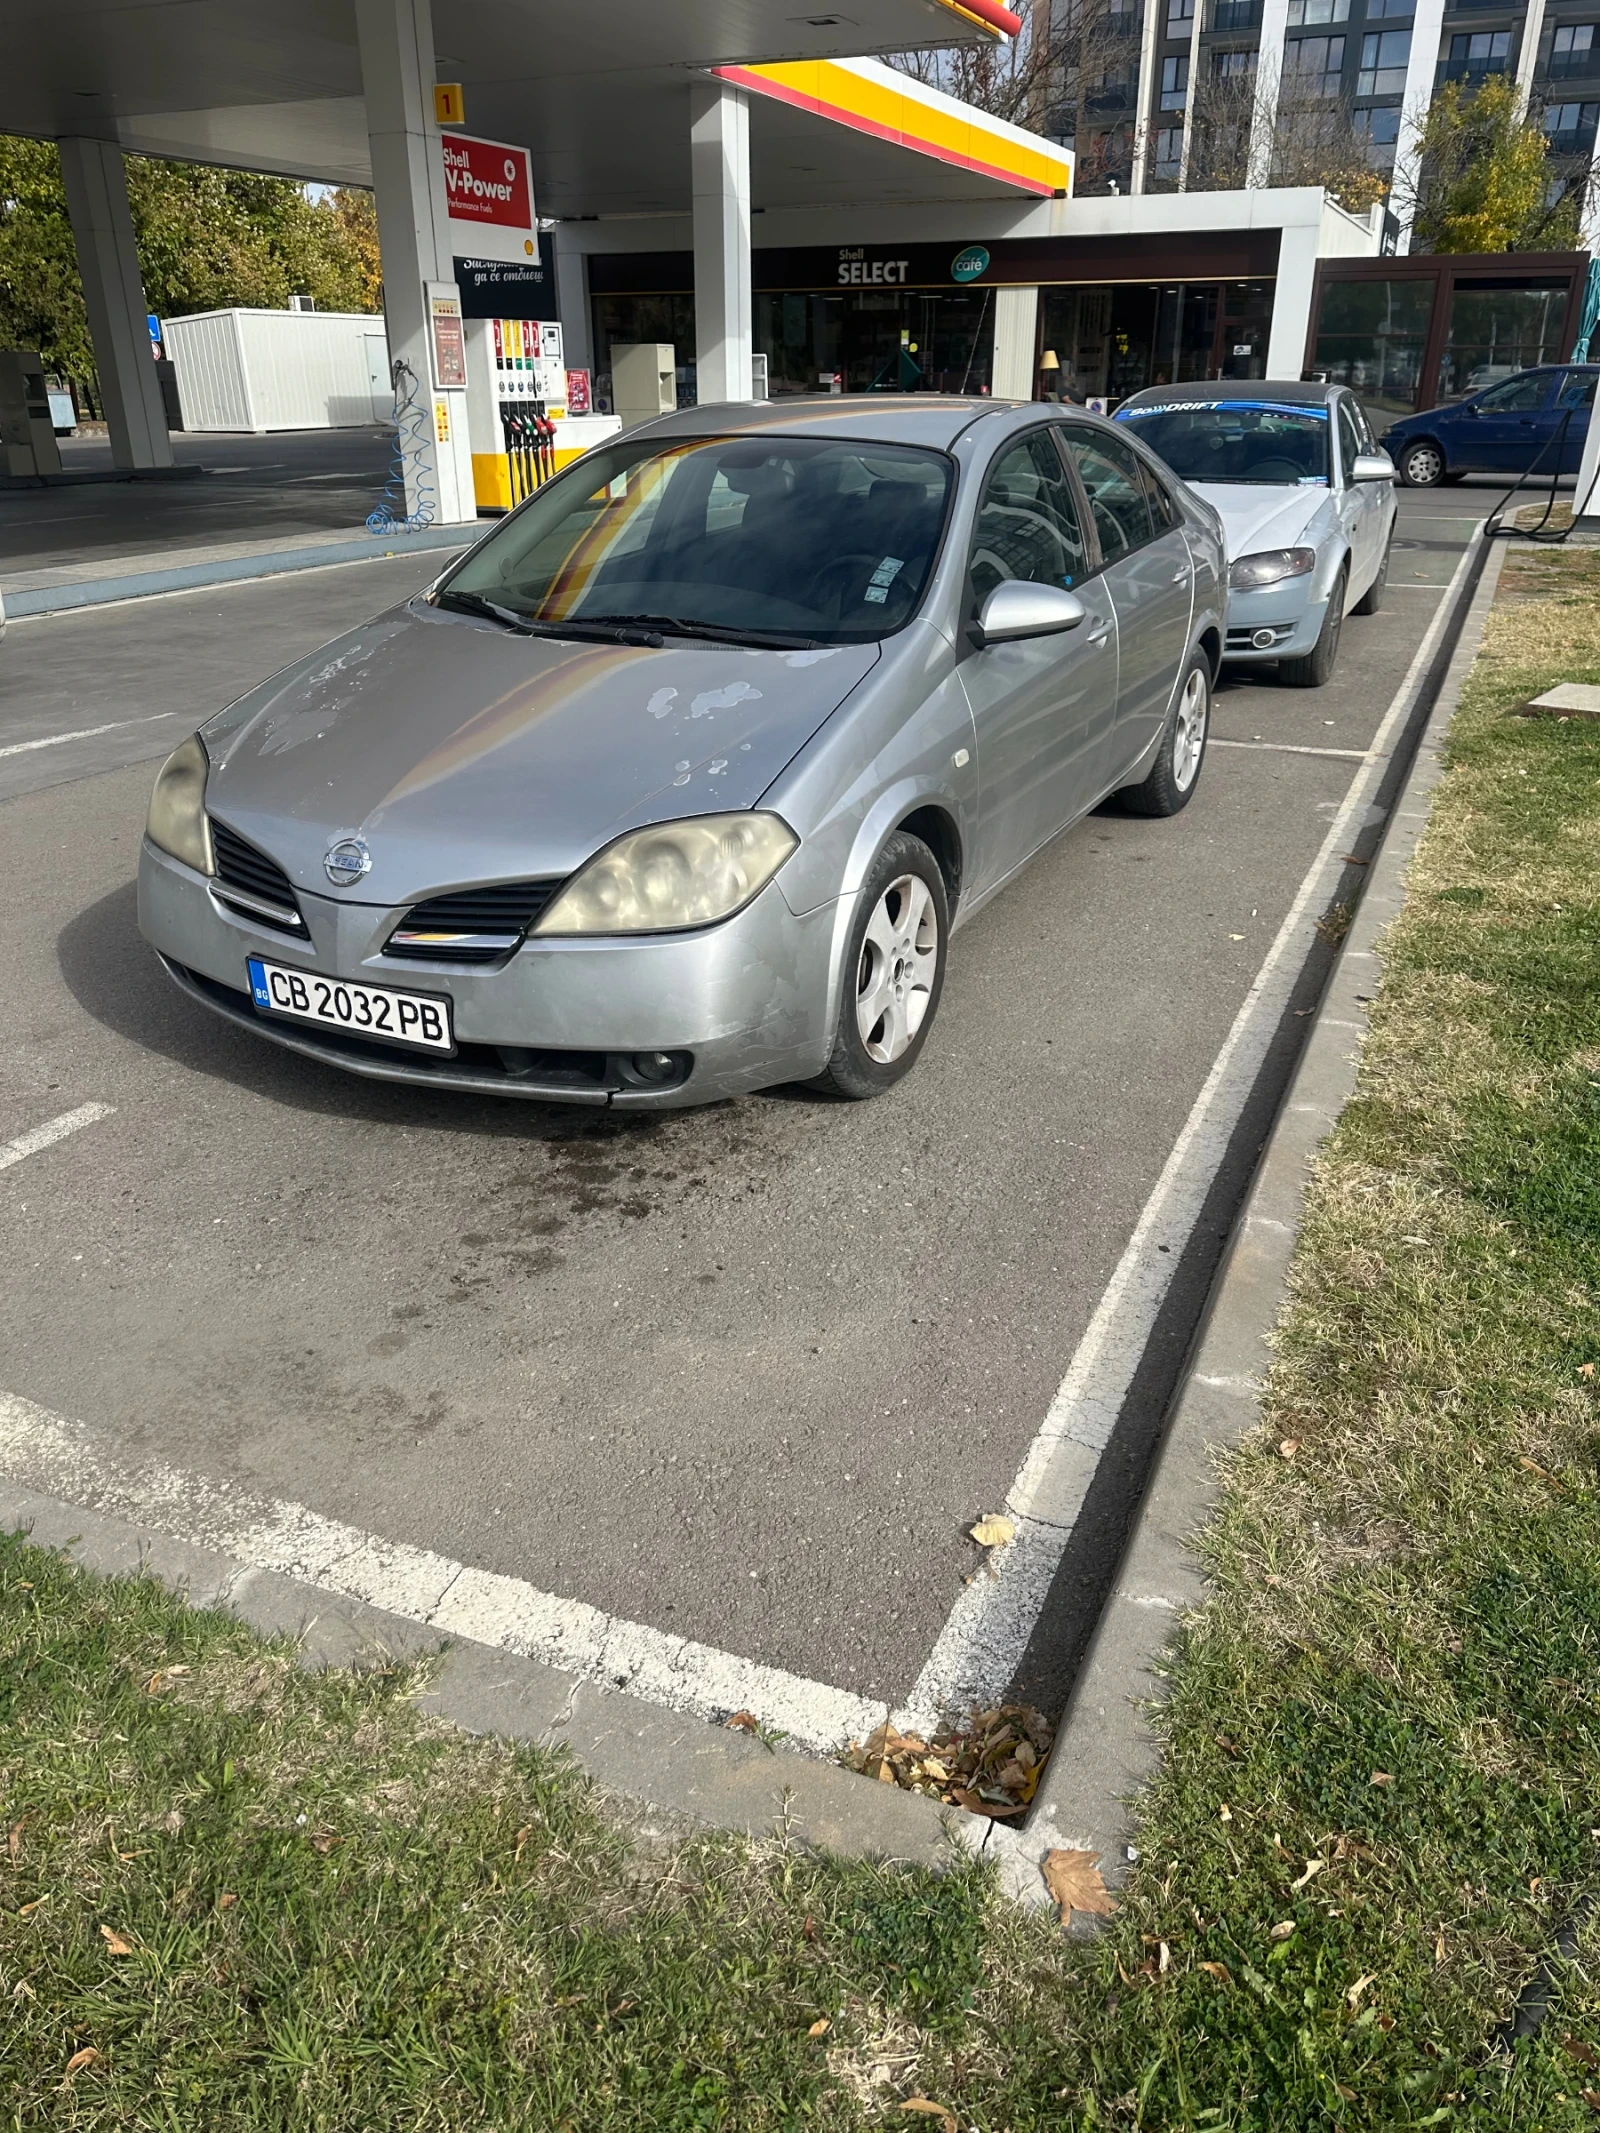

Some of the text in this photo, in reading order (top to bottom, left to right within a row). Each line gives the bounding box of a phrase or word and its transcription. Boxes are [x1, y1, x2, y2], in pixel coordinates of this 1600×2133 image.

[442, 94, 450, 114] 1
[443, 147, 469, 168] Shell
[445, 168, 512, 201] V-Power
[480, 203, 492, 213] Fuels
[839, 249, 864, 260] Shell
[838, 261, 908, 283] SELECT
[956, 257, 982, 271] café
[474, 272, 488, 286] да
[490, 272, 501, 282] се
[255, 988, 269, 1000] BG
[314, 982, 394, 1032] 2032
